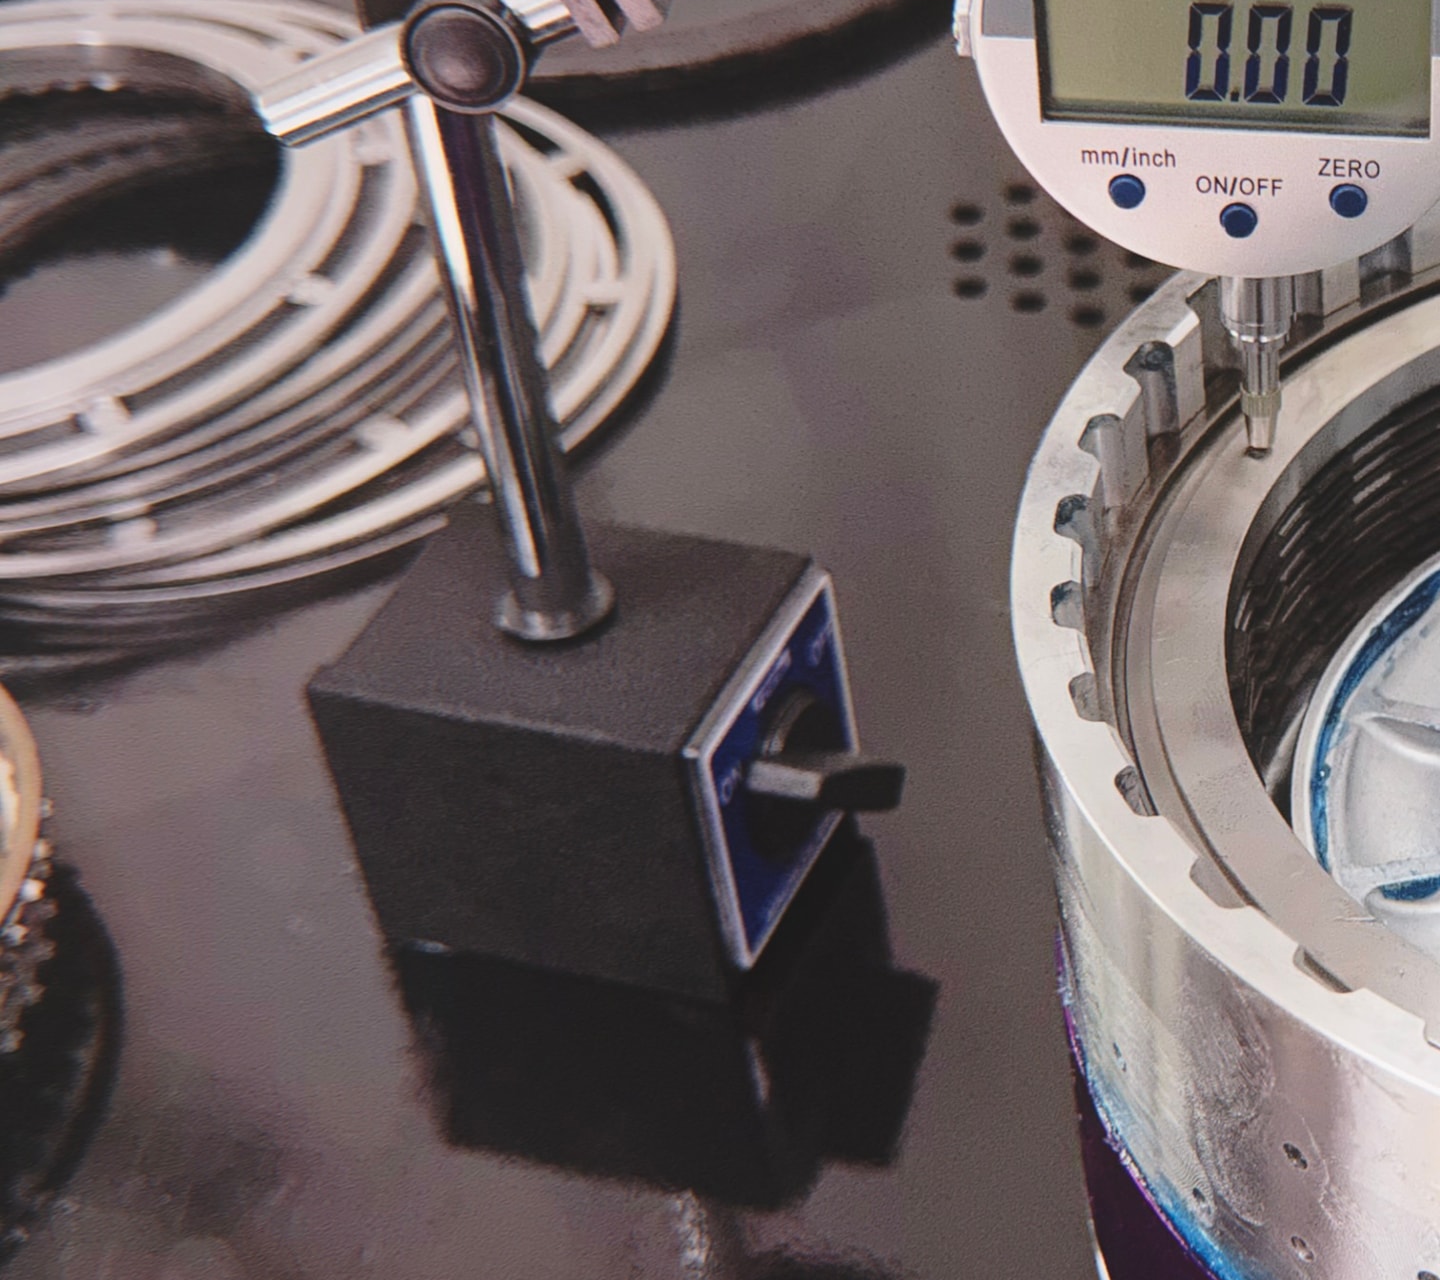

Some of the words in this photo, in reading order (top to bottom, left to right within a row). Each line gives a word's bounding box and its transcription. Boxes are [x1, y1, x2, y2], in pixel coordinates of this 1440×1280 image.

[1184, 0, 1354, 107] 0.00
[1081, 147, 1177, 169] mm/inch
[1317, 157, 1381, 180] ZERO
[1195, 176, 1283, 199] ON/OFF
